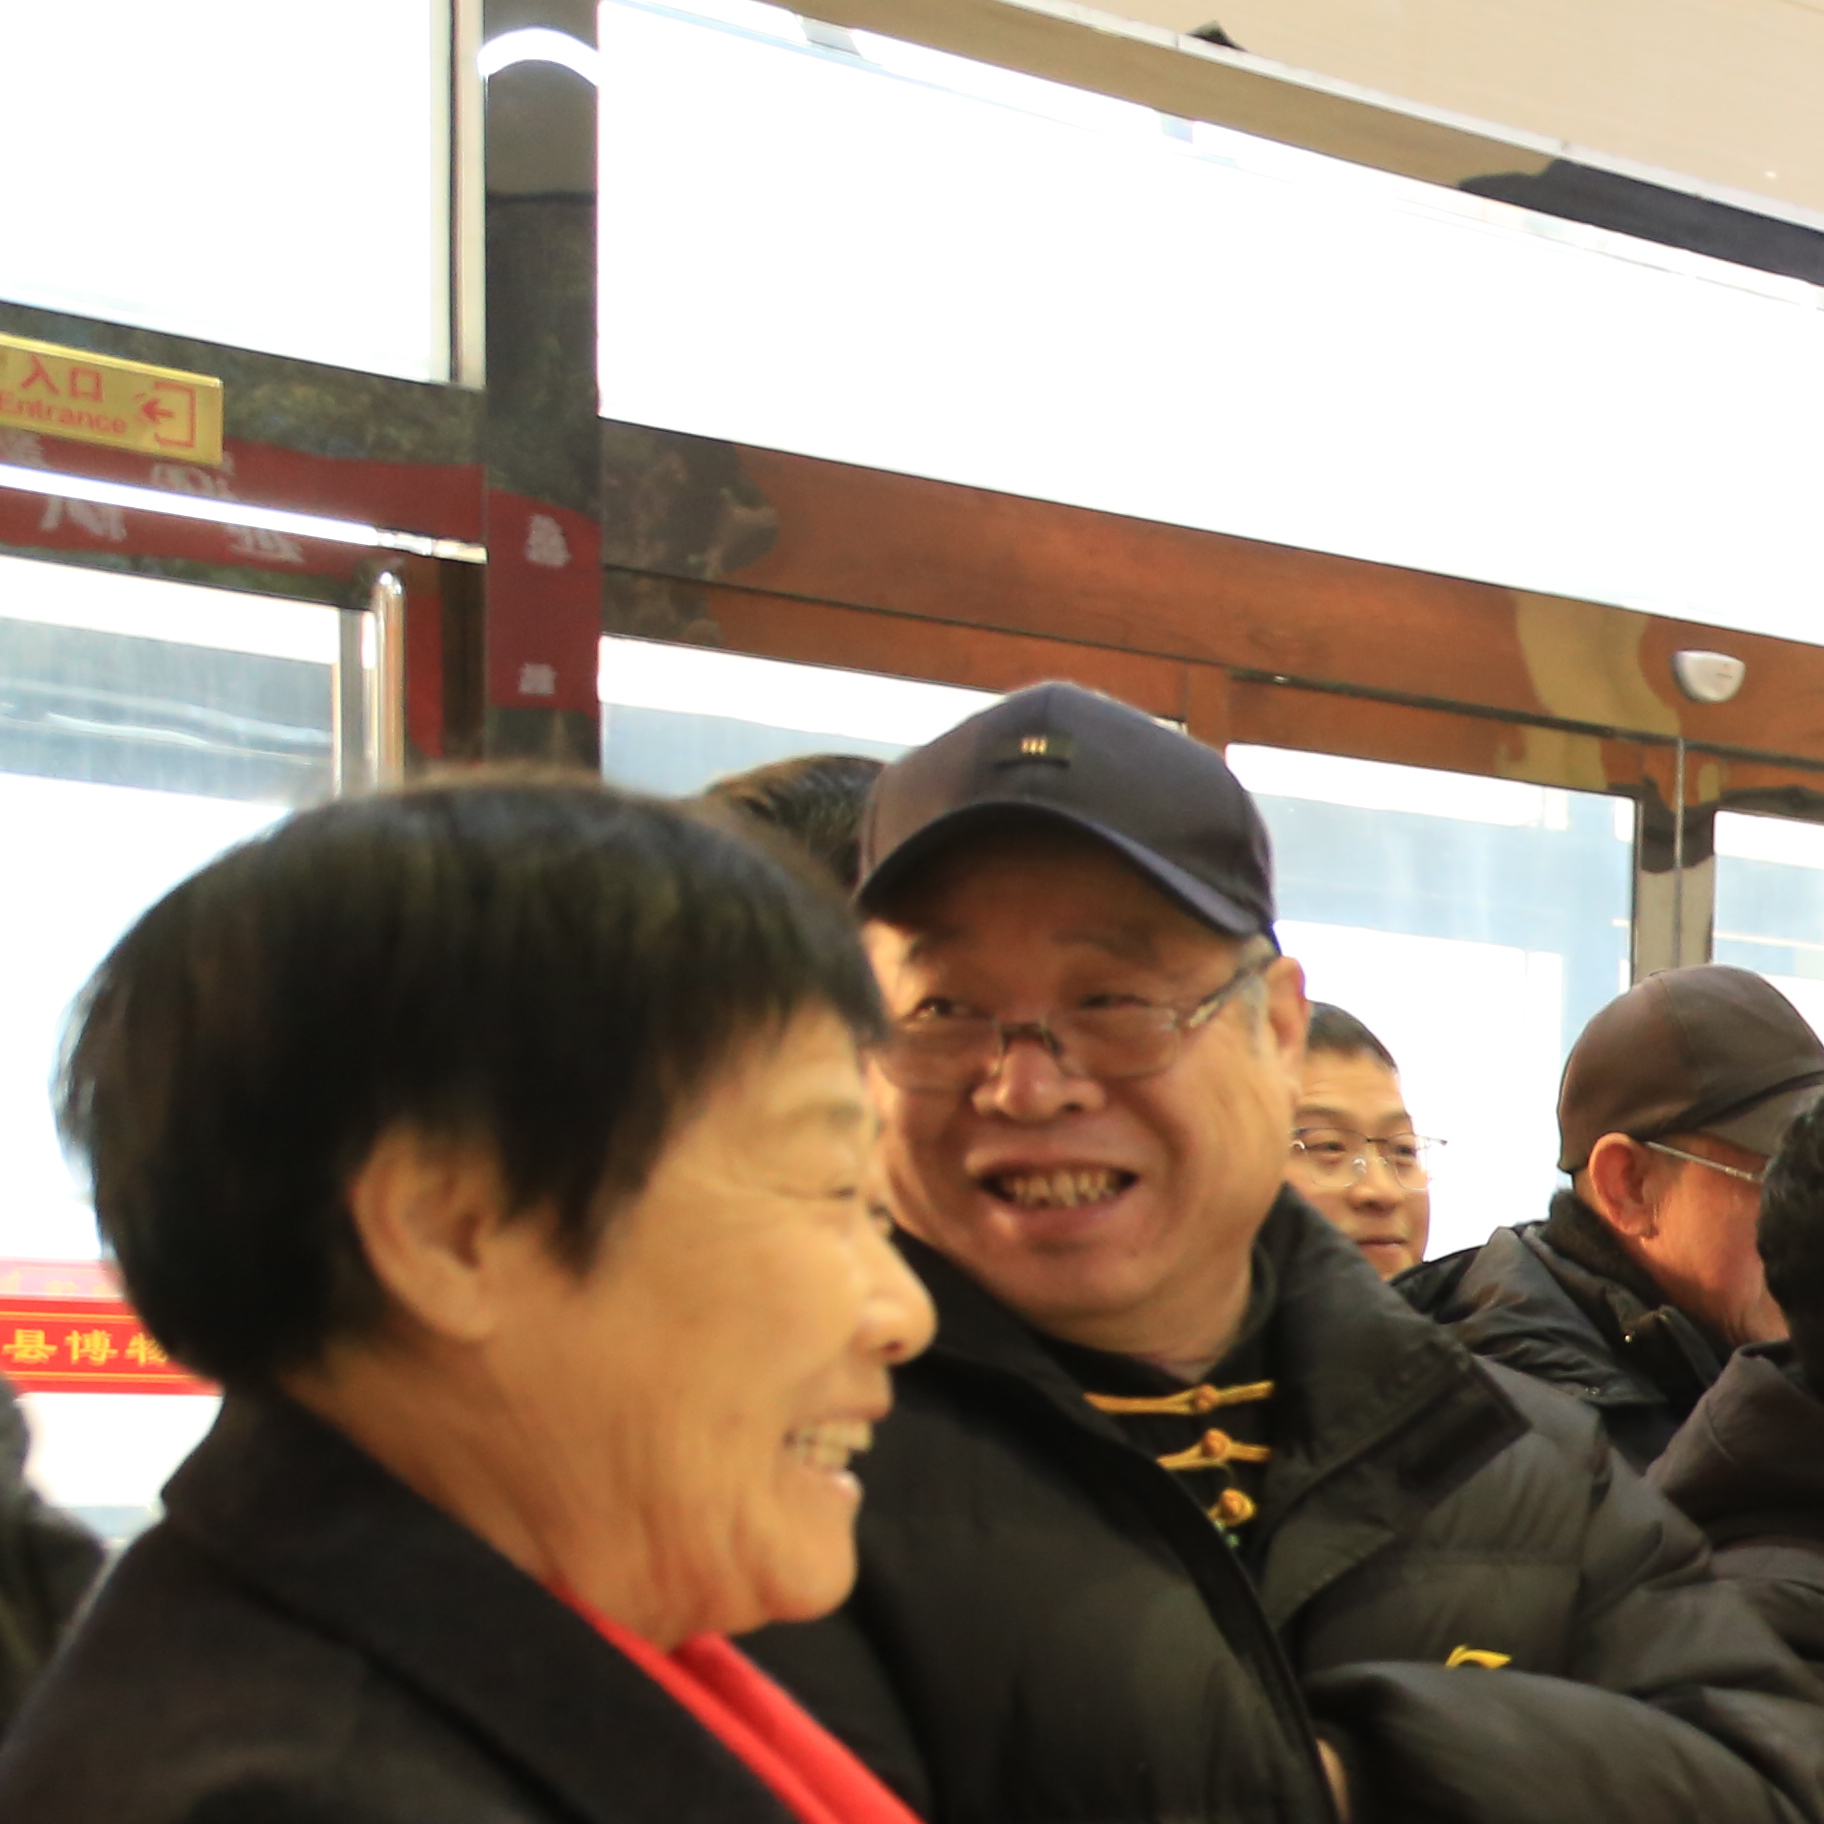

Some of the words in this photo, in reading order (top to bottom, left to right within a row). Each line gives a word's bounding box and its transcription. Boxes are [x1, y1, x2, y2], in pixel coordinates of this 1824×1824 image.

[21, 353, 103, 402] 入口
[2, 1328, 170, 1367] 县博物
